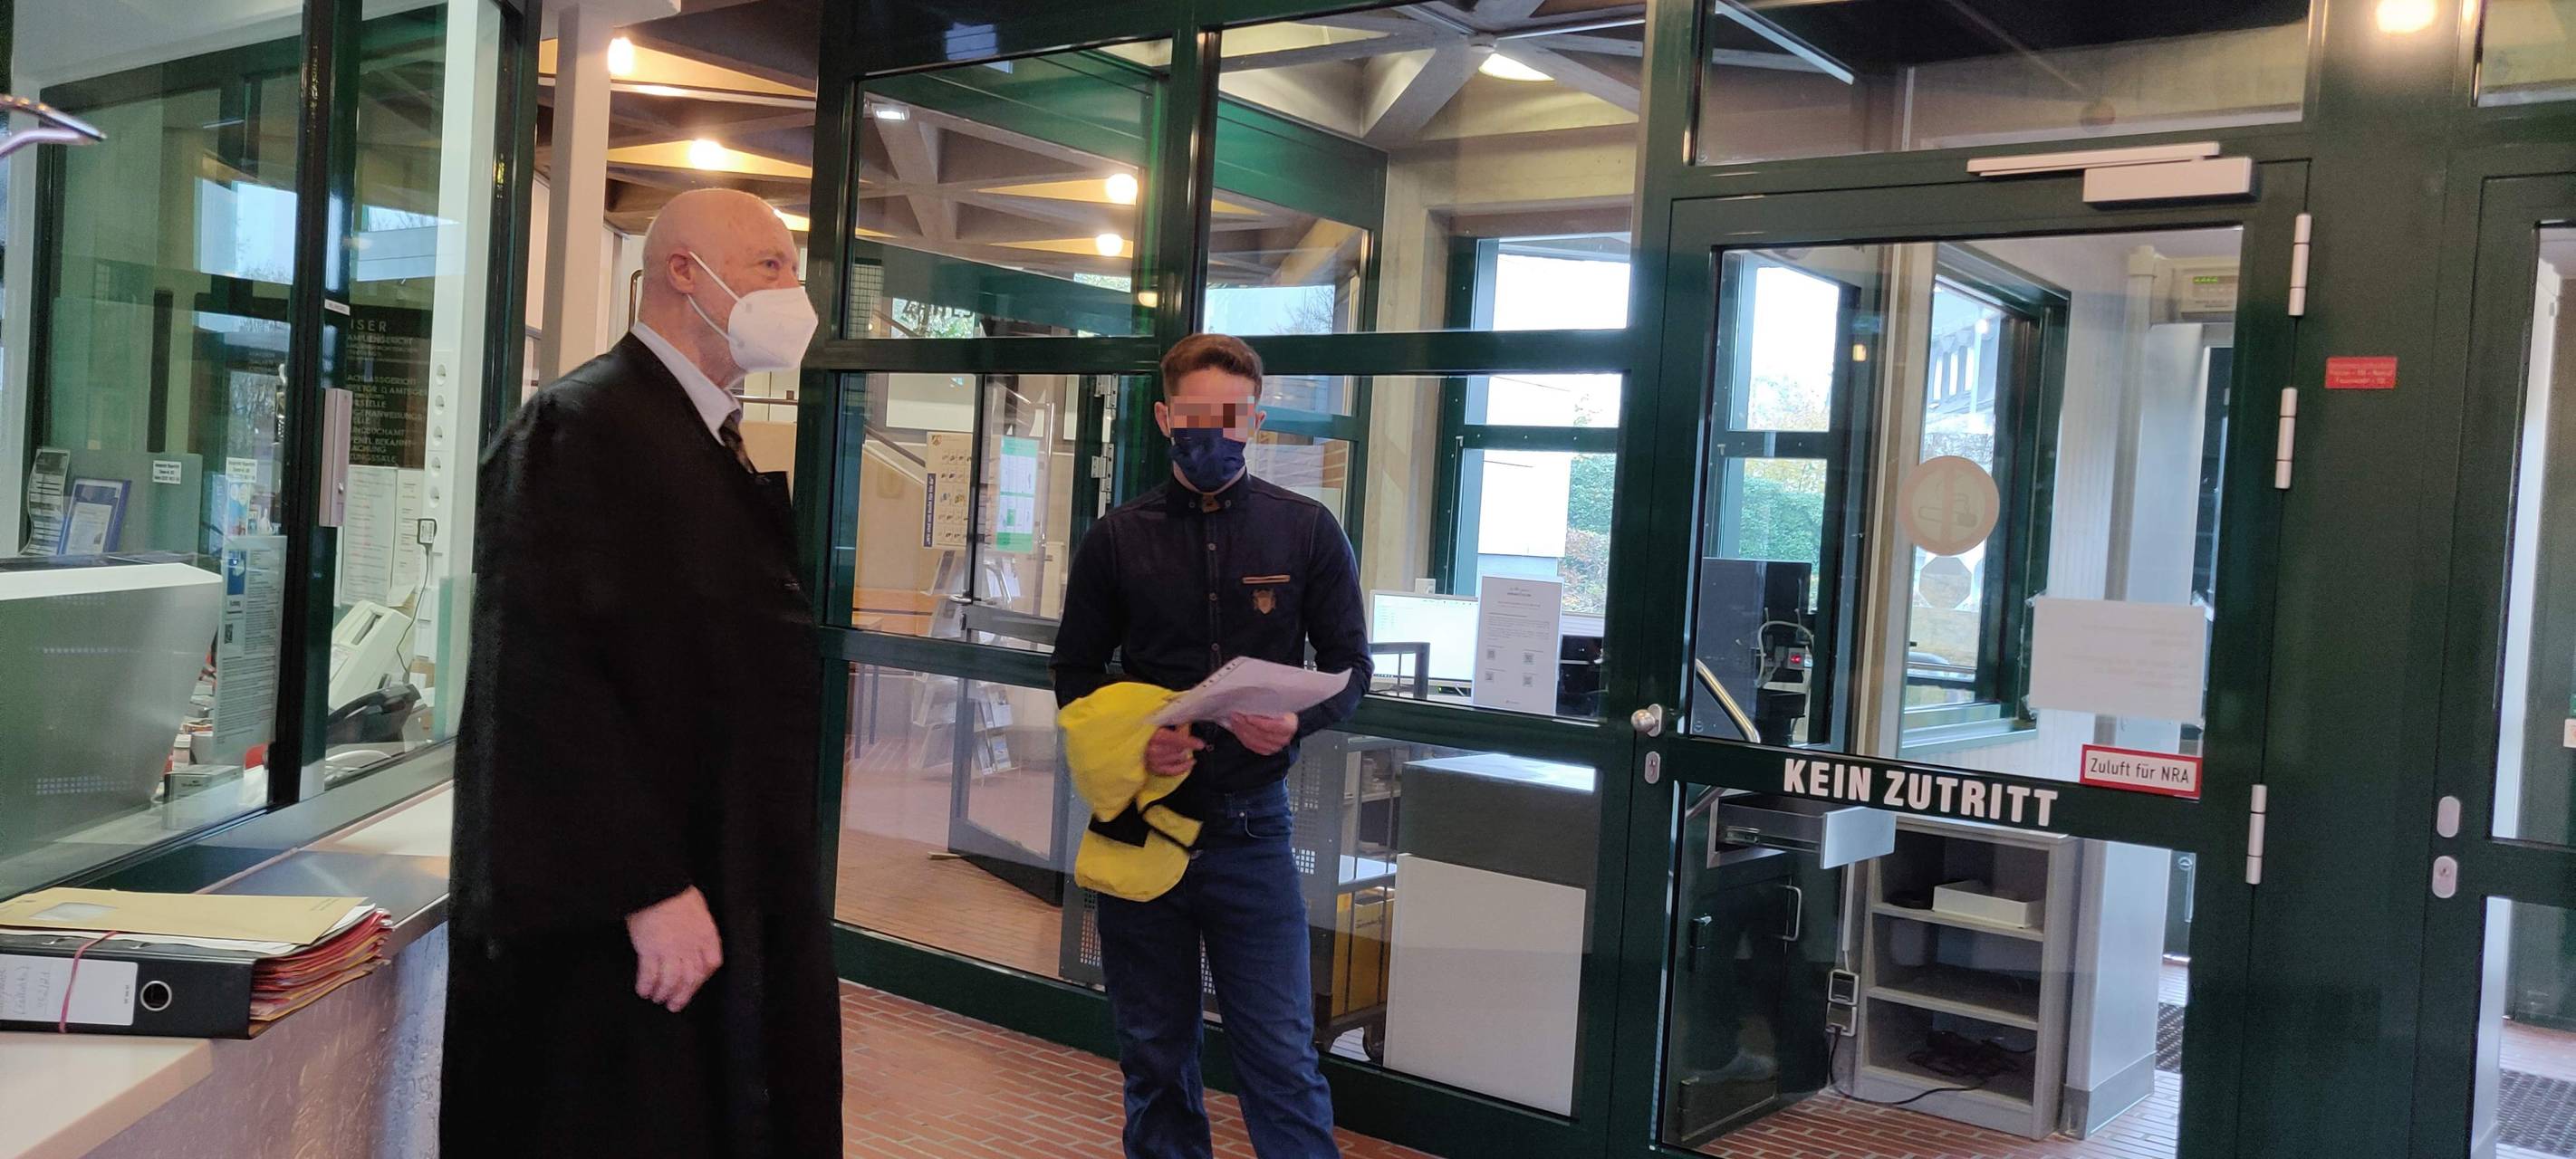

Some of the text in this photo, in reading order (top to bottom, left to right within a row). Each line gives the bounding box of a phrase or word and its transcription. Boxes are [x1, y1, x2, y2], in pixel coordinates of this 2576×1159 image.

[1783, 758, 2059, 827] KEIN ZUTRITT
[2091, 757, 2189, 784] Zuluft für NRA
